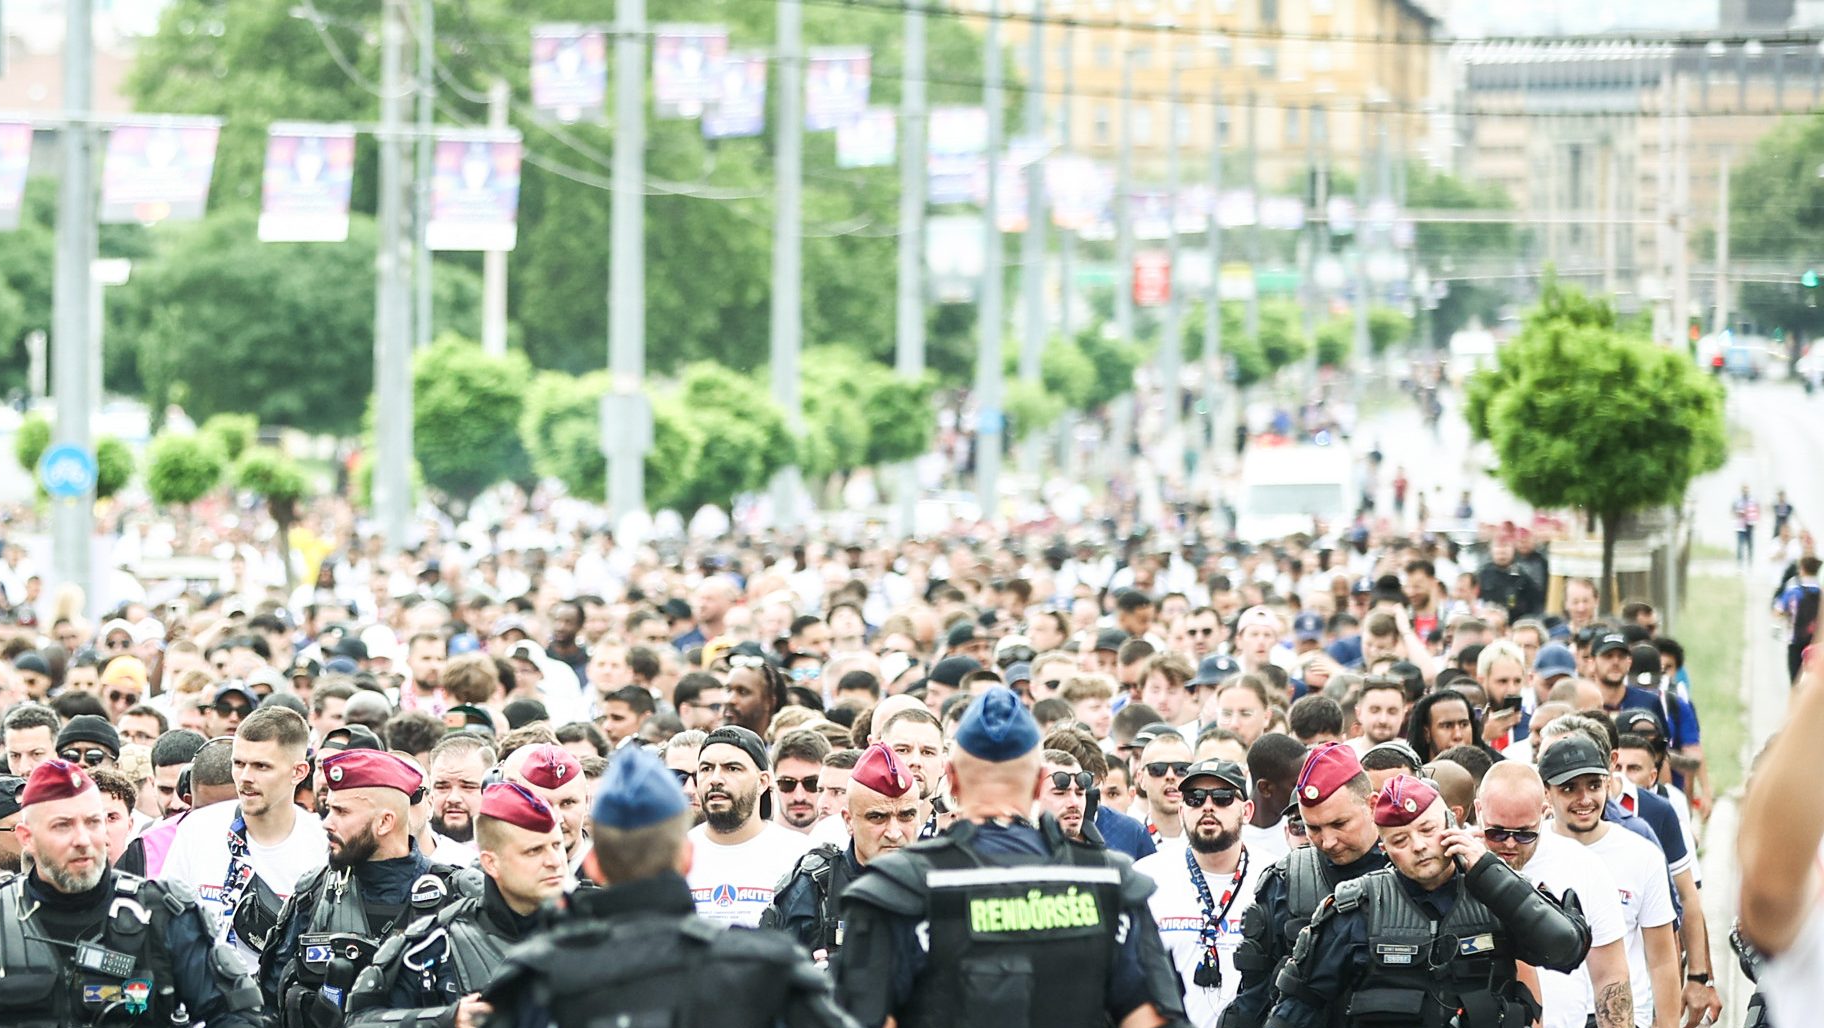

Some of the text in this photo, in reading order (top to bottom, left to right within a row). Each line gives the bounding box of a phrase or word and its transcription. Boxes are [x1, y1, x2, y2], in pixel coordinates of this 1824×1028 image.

[200, 886, 223, 901] VIR
[970, 885, 1099, 932] RENDŐRSÉG
[1161, 919, 1204, 931] VIRAGE
